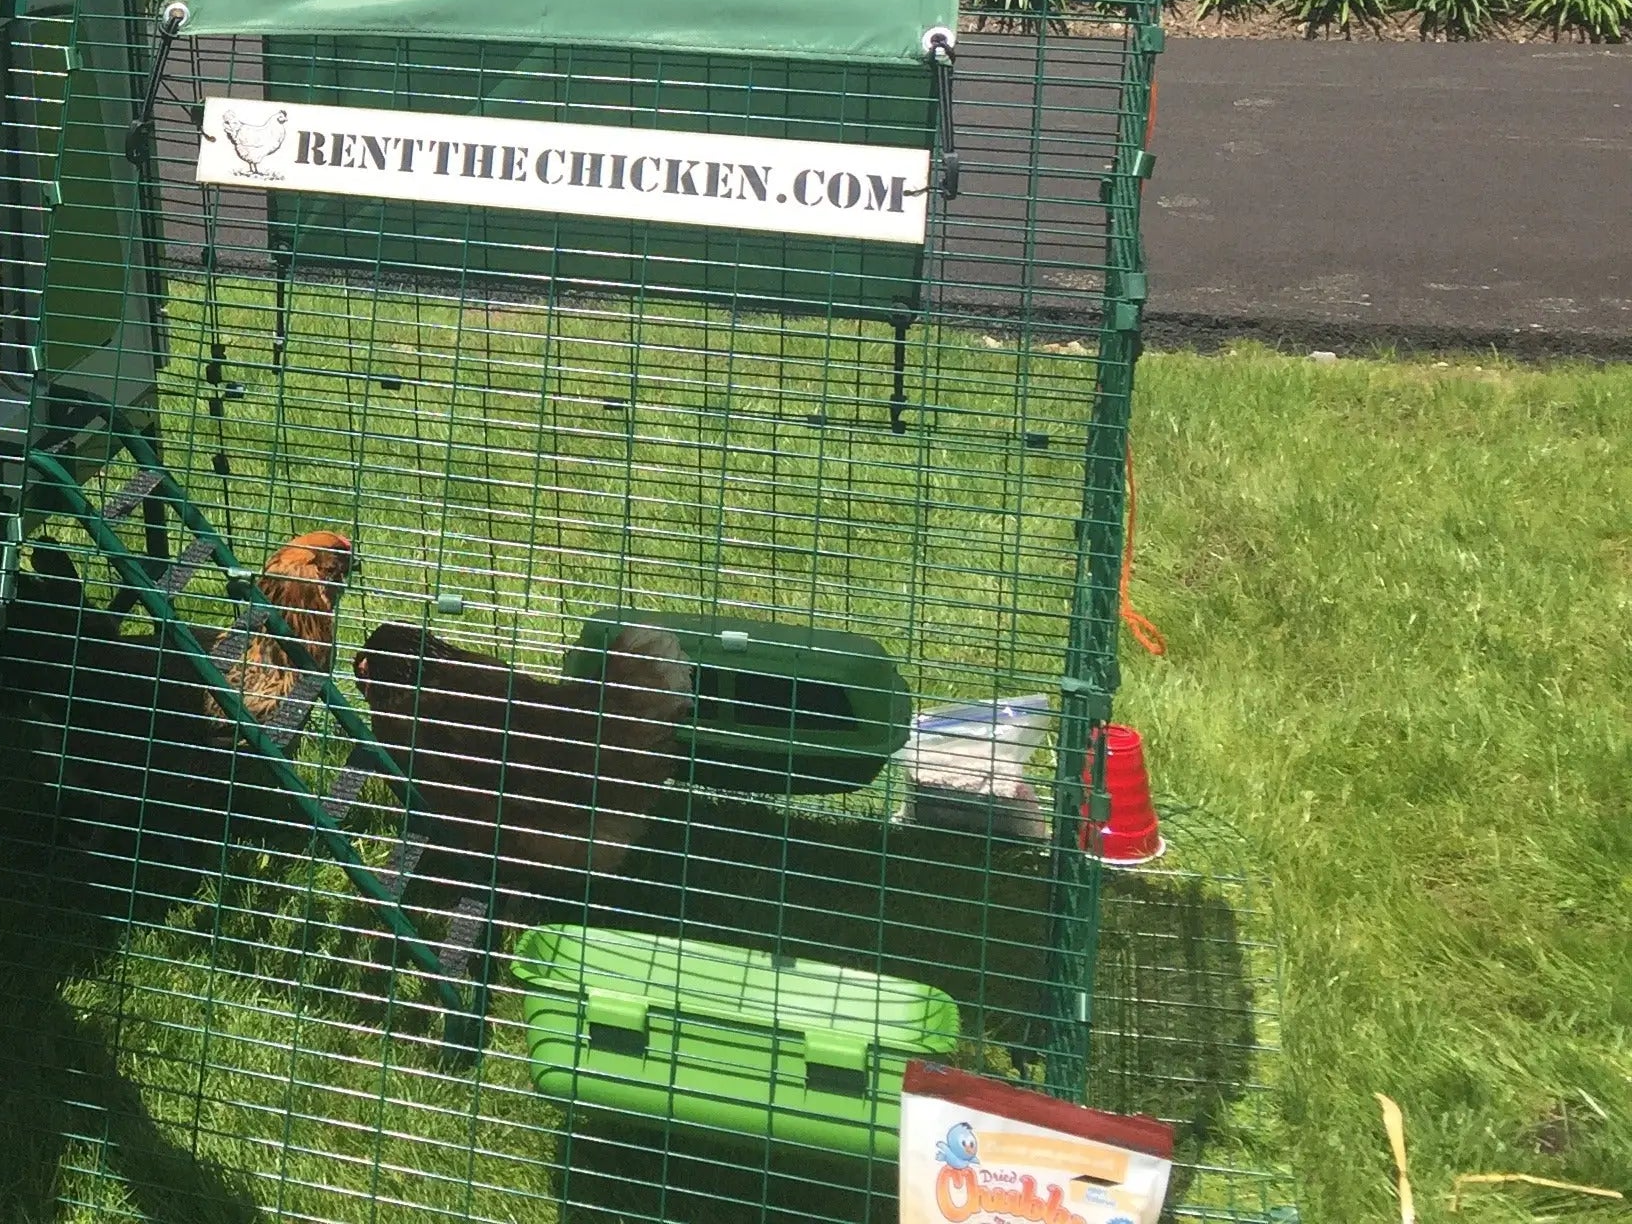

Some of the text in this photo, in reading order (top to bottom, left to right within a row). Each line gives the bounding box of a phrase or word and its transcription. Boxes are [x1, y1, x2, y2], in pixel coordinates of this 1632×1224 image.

[294, 129, 907, 213] RENTTHECHICKEN.COM
[936, 1164, 1087, 1224] Chubb
[979, 1169, 1018, 1184] Dried
